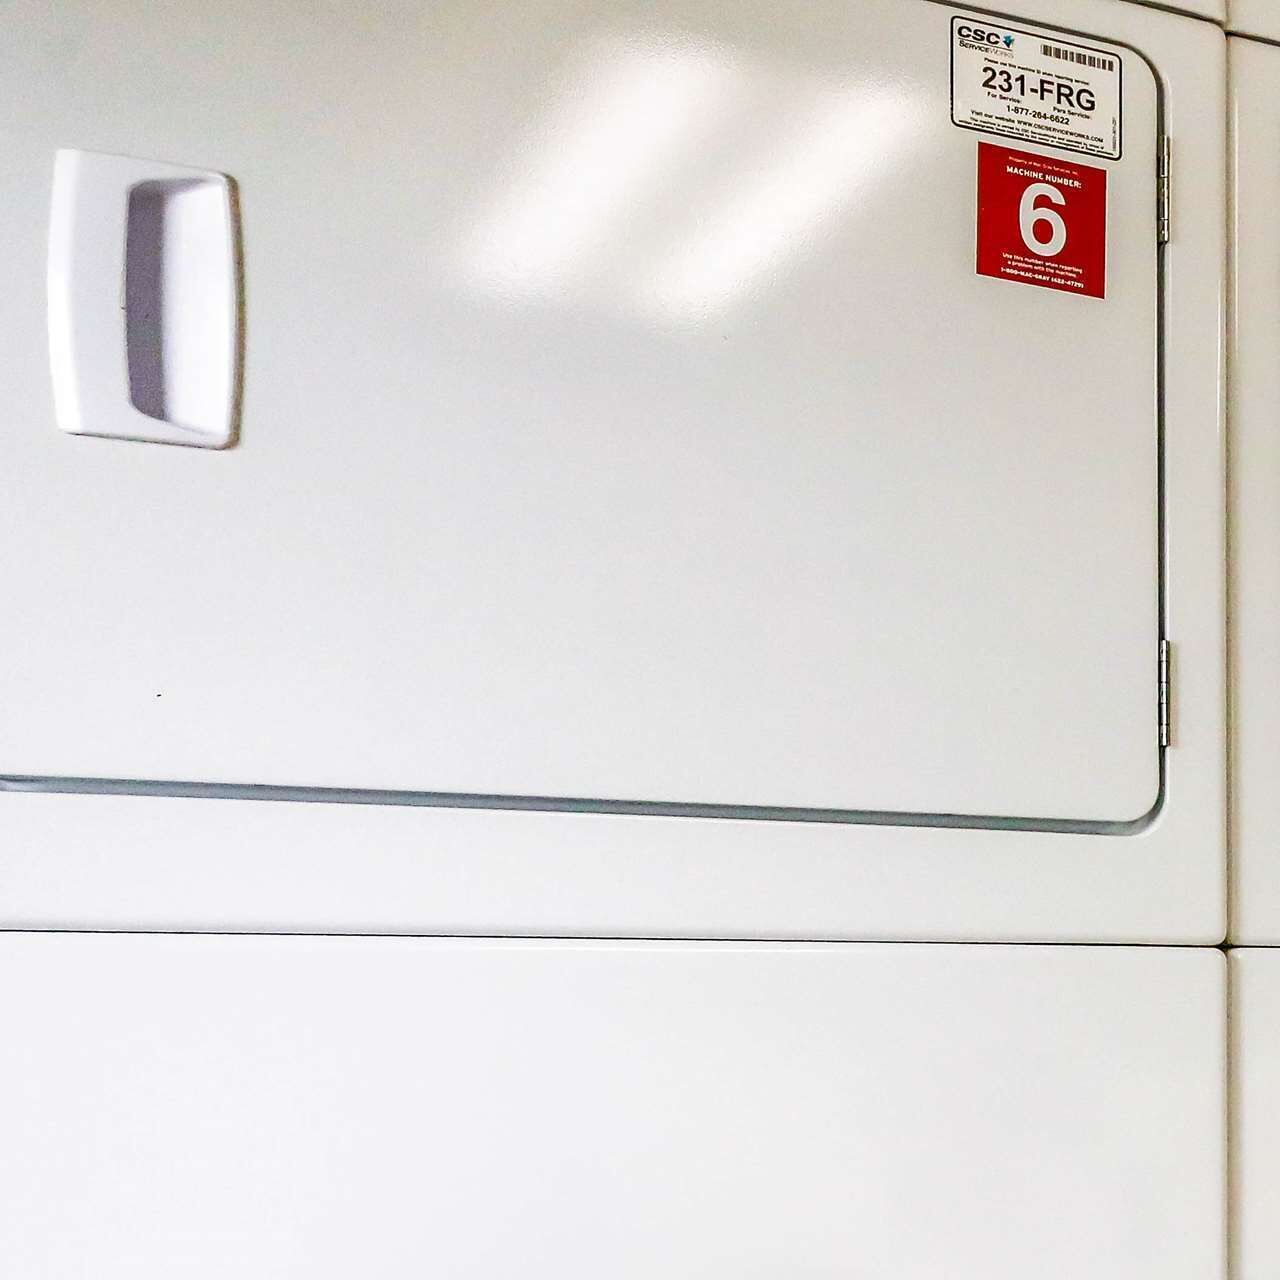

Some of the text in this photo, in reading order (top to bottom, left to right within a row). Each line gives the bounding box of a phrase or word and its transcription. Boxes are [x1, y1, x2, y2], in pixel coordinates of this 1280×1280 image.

[957, 26, 1000, 45] CSC
[982, 66, 1096, 111] 231-FRG
[1006, 165, 1043, 180] MACHINE
[1045, 174, 1082, 189] NUMBER:
[1019, 182, 1067, 257] 6
